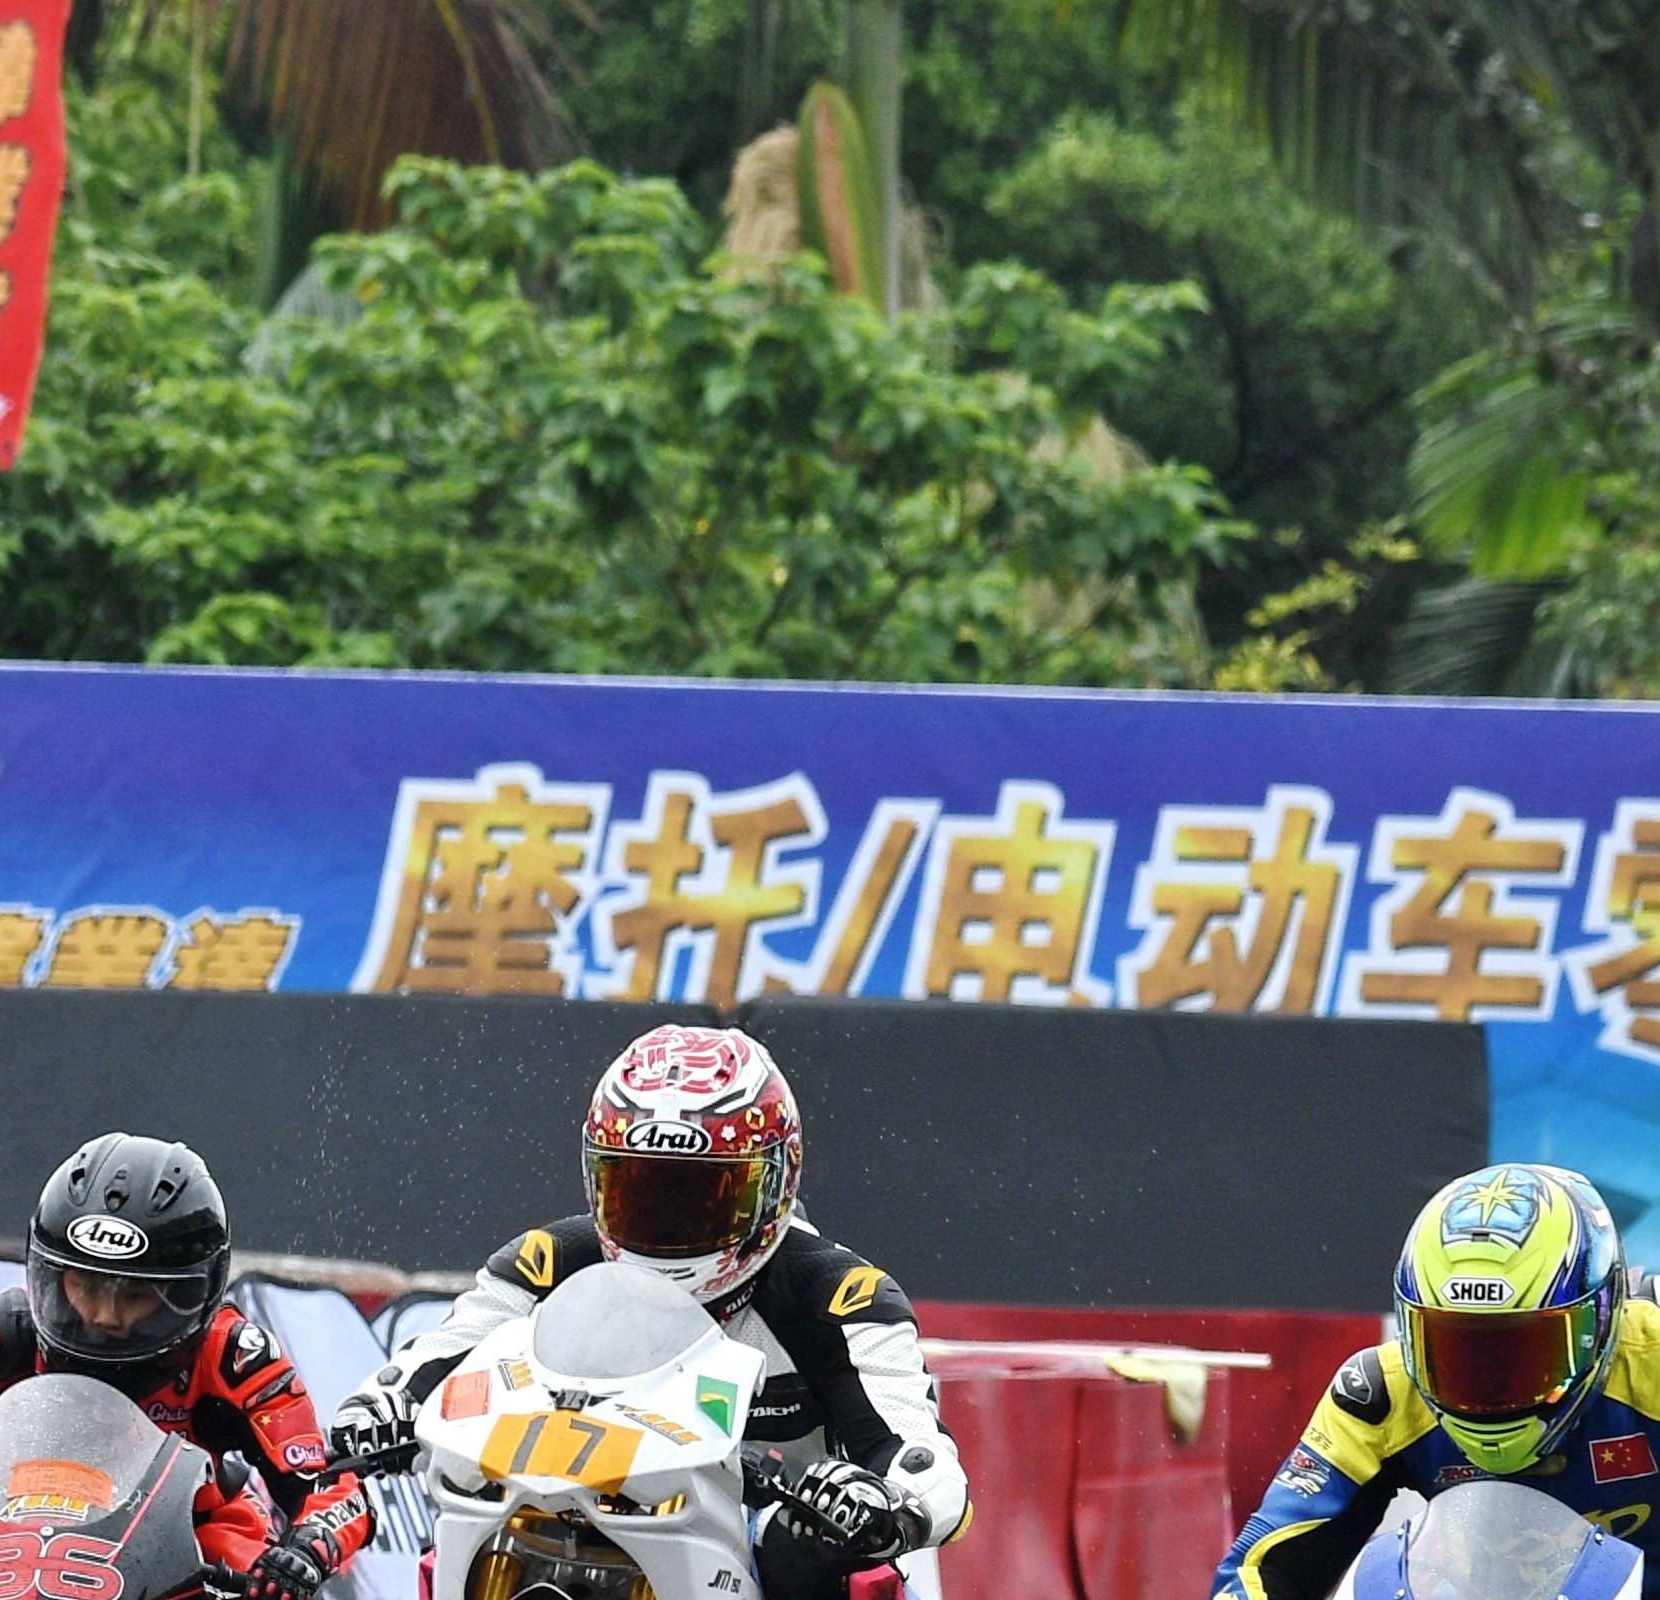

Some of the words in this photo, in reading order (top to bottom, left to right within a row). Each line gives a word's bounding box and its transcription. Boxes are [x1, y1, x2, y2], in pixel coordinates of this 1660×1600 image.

[629, 1124, 698, 1150] Arai
[72, 1220, 135, 1249] Arai
[1449, 1282, 1504, 1301] SHOEI
[508, 1414, 607, 1478] 17
